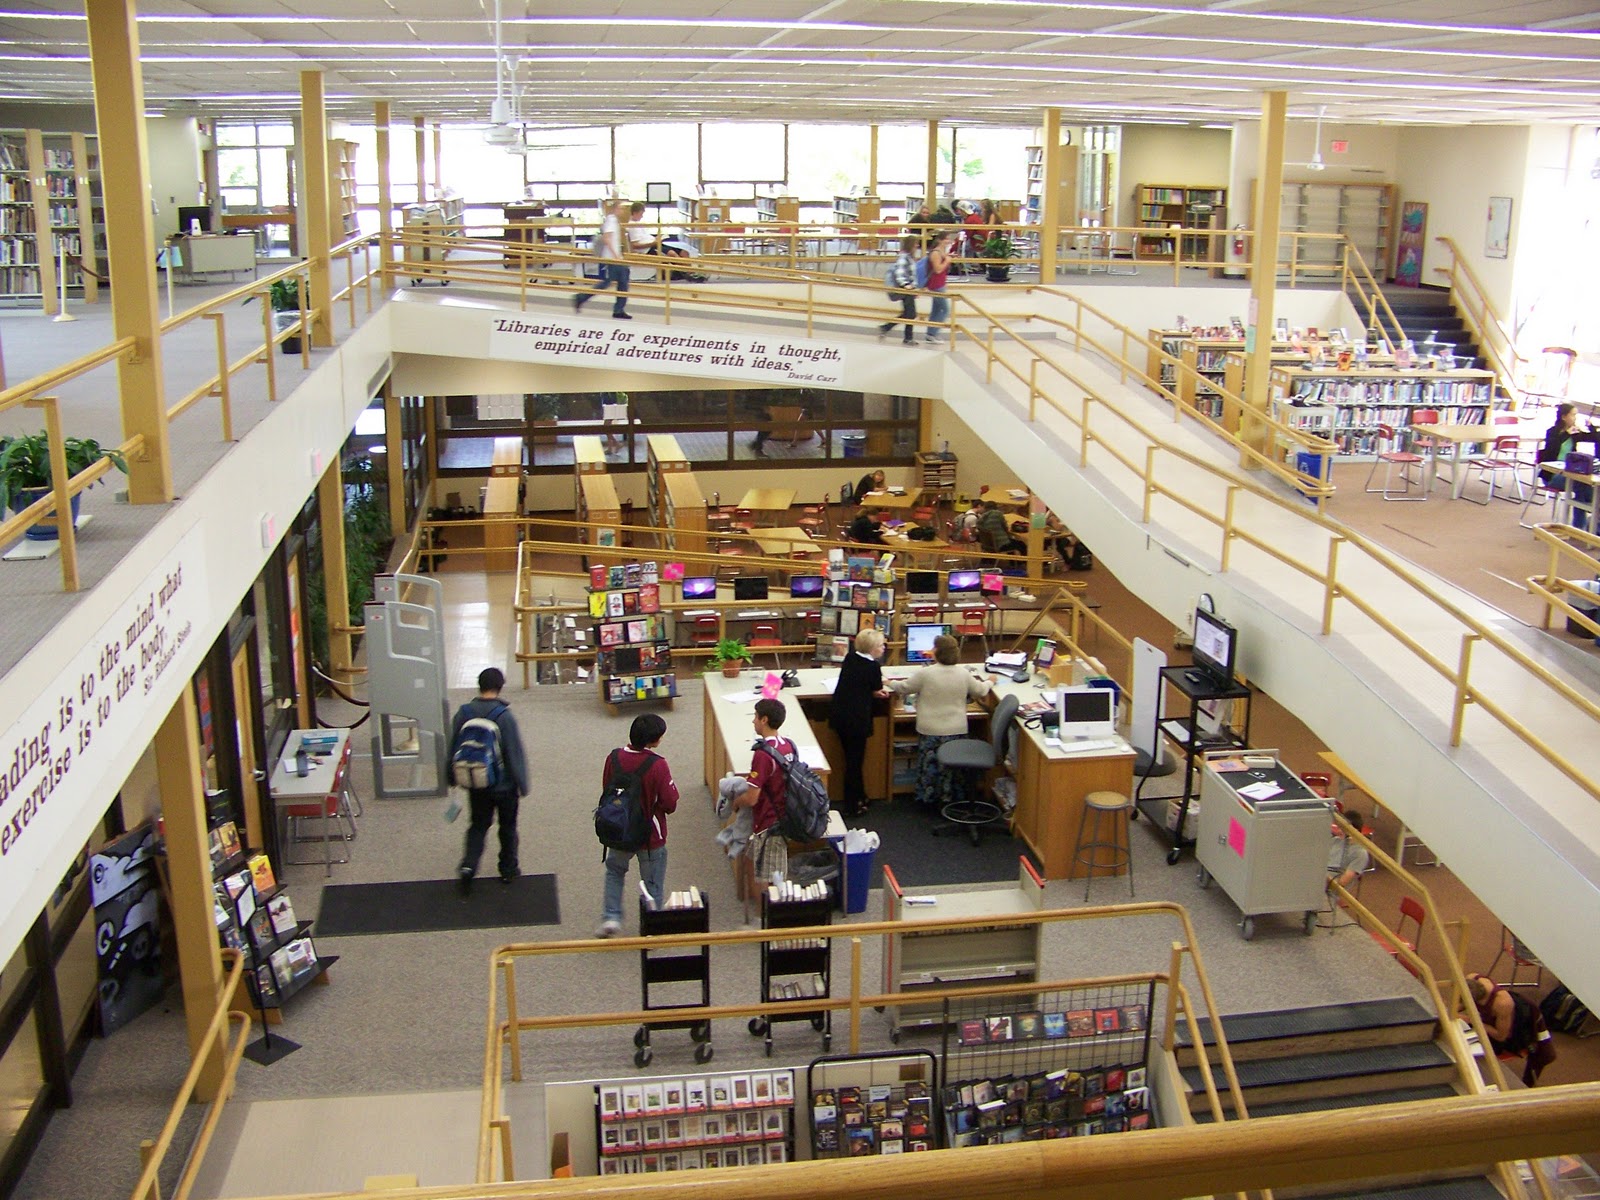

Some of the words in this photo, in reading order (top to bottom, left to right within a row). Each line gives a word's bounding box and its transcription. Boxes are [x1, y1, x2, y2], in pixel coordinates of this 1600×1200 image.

[534, 339, 610, 355] empirical
[616, 345, 703, 364] adventures
[710, 353, 745, 367] with
[578, 328, 604, 339] are
[610, 329, 635, 343] for
[643, 332, 740, 352] experiments
[749, 341, 766, 354] in
[778, 344, 842, 362] thought,
[787, 372, 813, 382] David
[816, 374, 838, 383] Carr
[59, 695, 74, 734] is
[80, 673, 95, 706] to
[100, 643, 120, 682] the
[125, 592, 155, 650] mind
[158, 561, 182, 609] what
[1, 746, 71, 857] exercise
[78, 719, 92, 756] is
[97, 696, 111, 728] to
[116, 664, 136, 703] the
